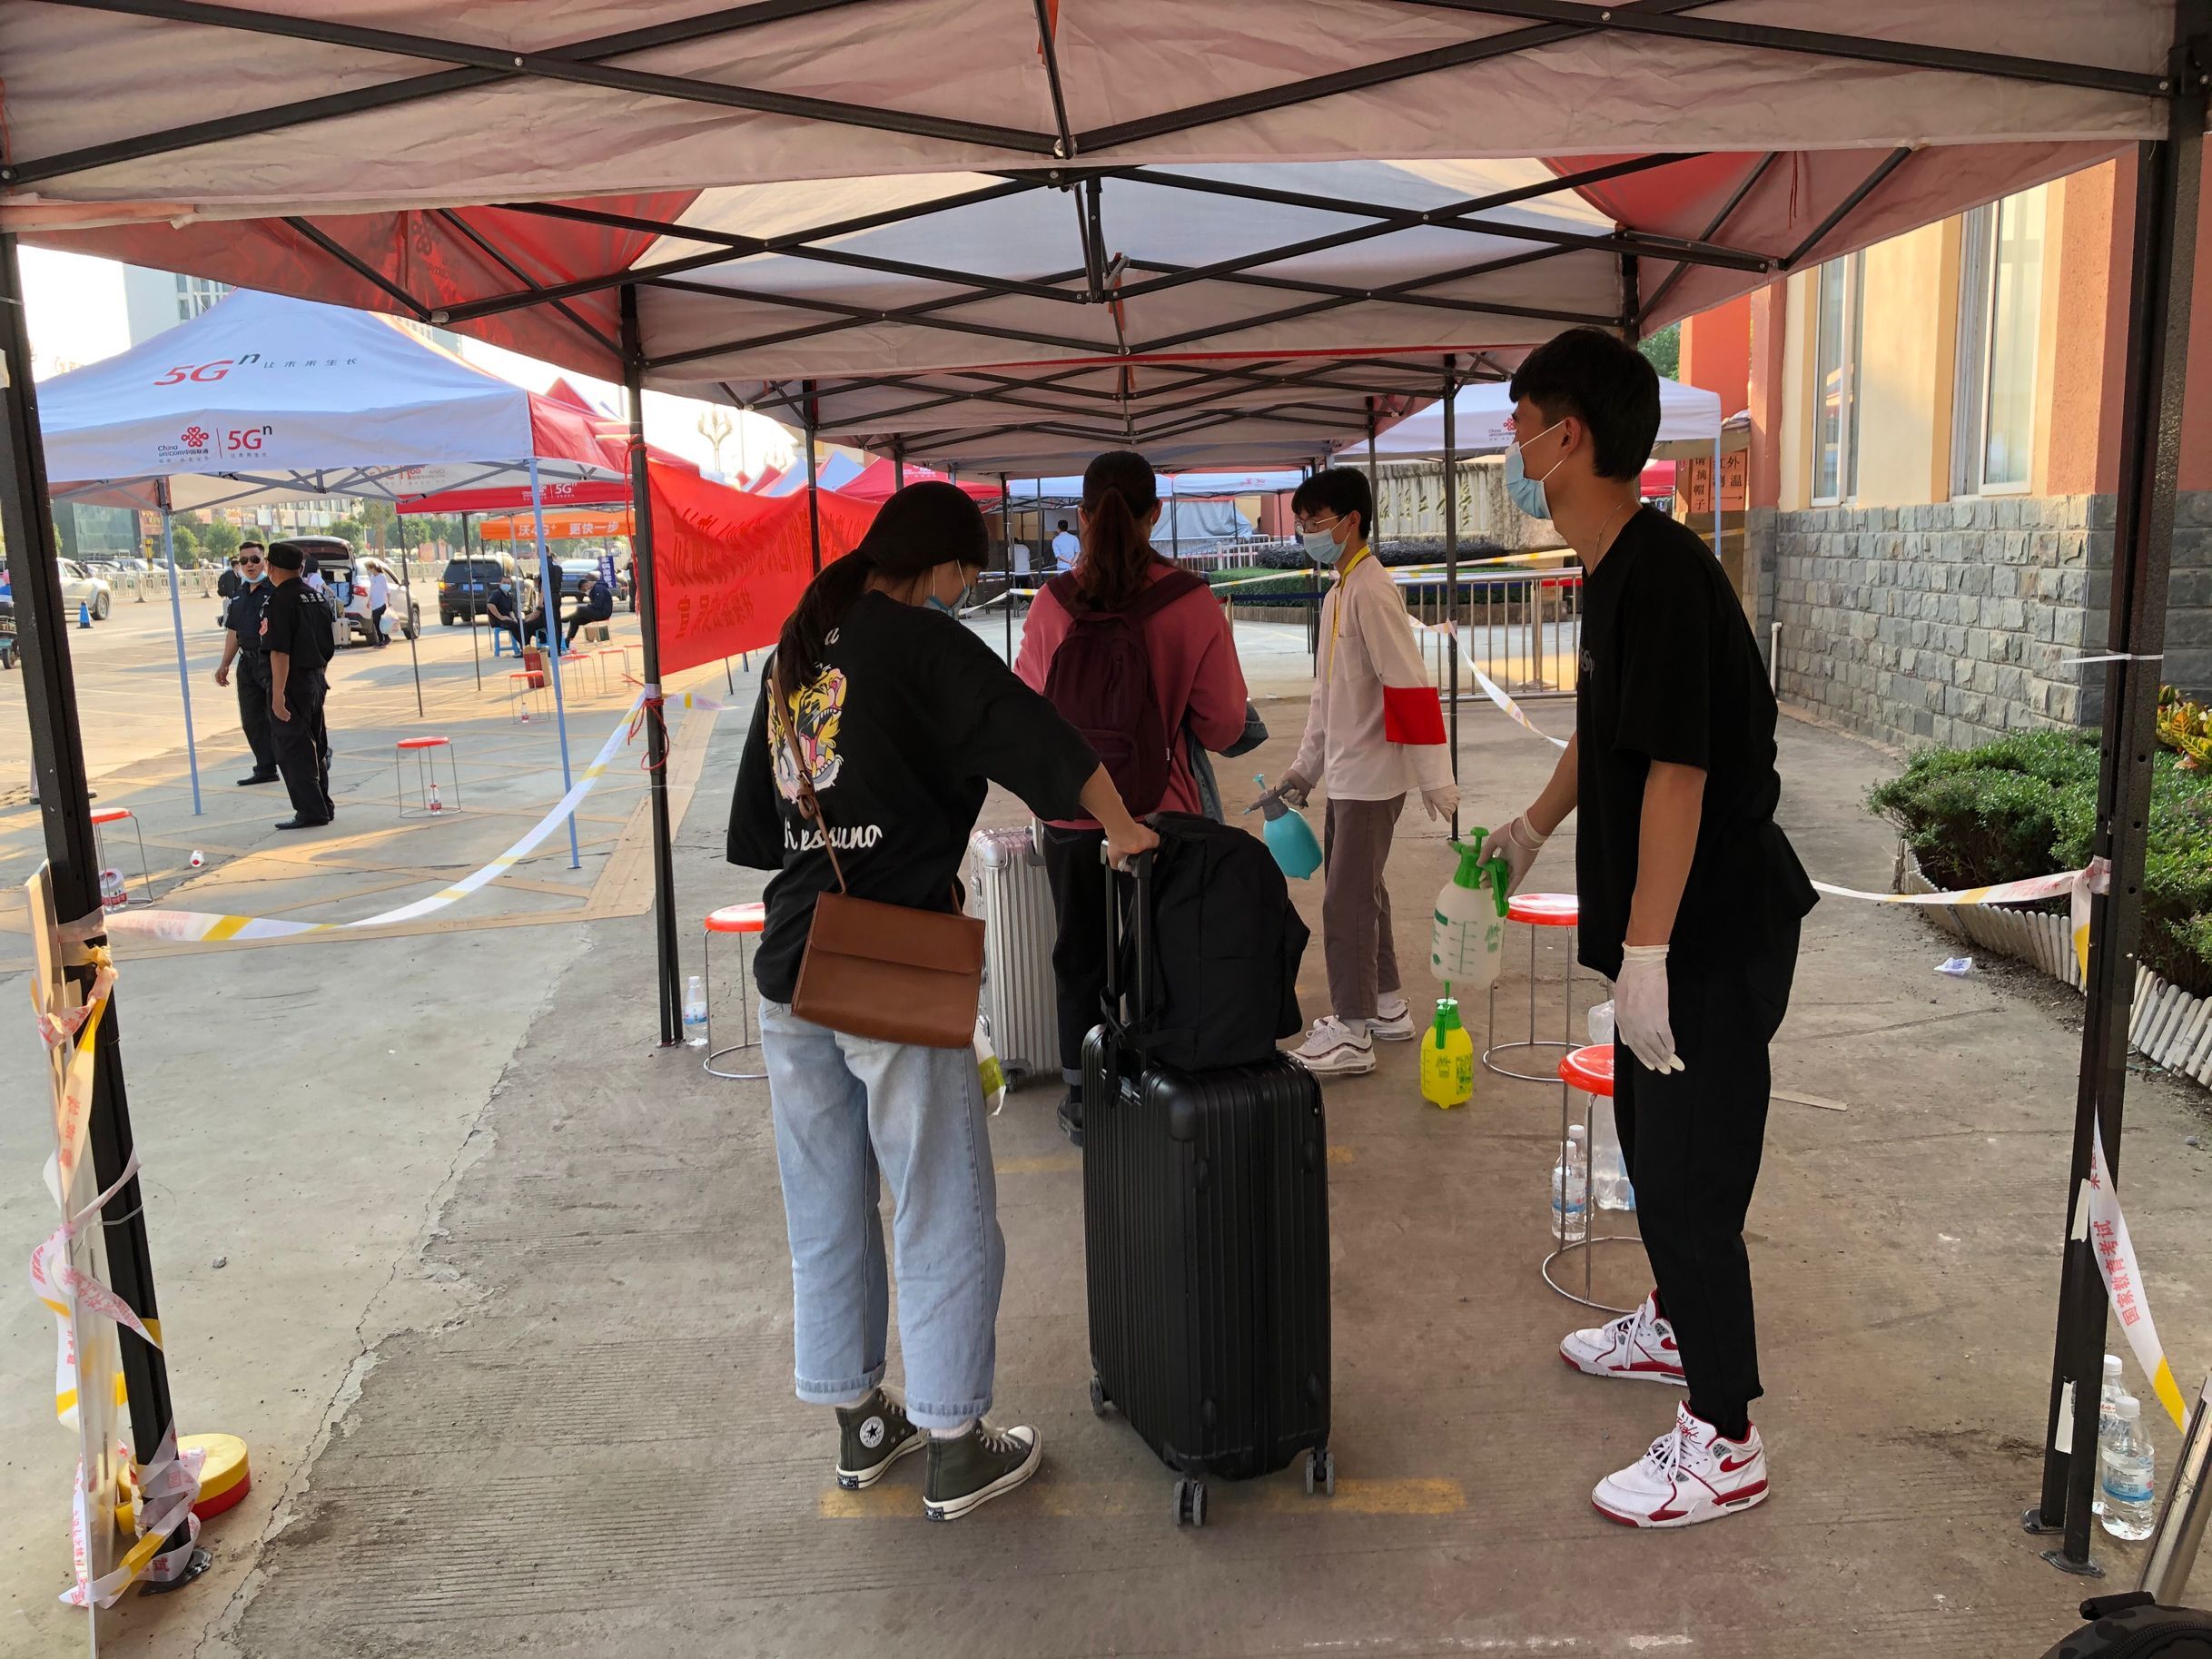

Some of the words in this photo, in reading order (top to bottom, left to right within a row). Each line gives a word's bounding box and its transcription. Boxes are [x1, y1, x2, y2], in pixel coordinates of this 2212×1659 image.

[568, 521, 619, 536] 更快一步
[2093, 1220, 2140, 1327] 国家教育考试
